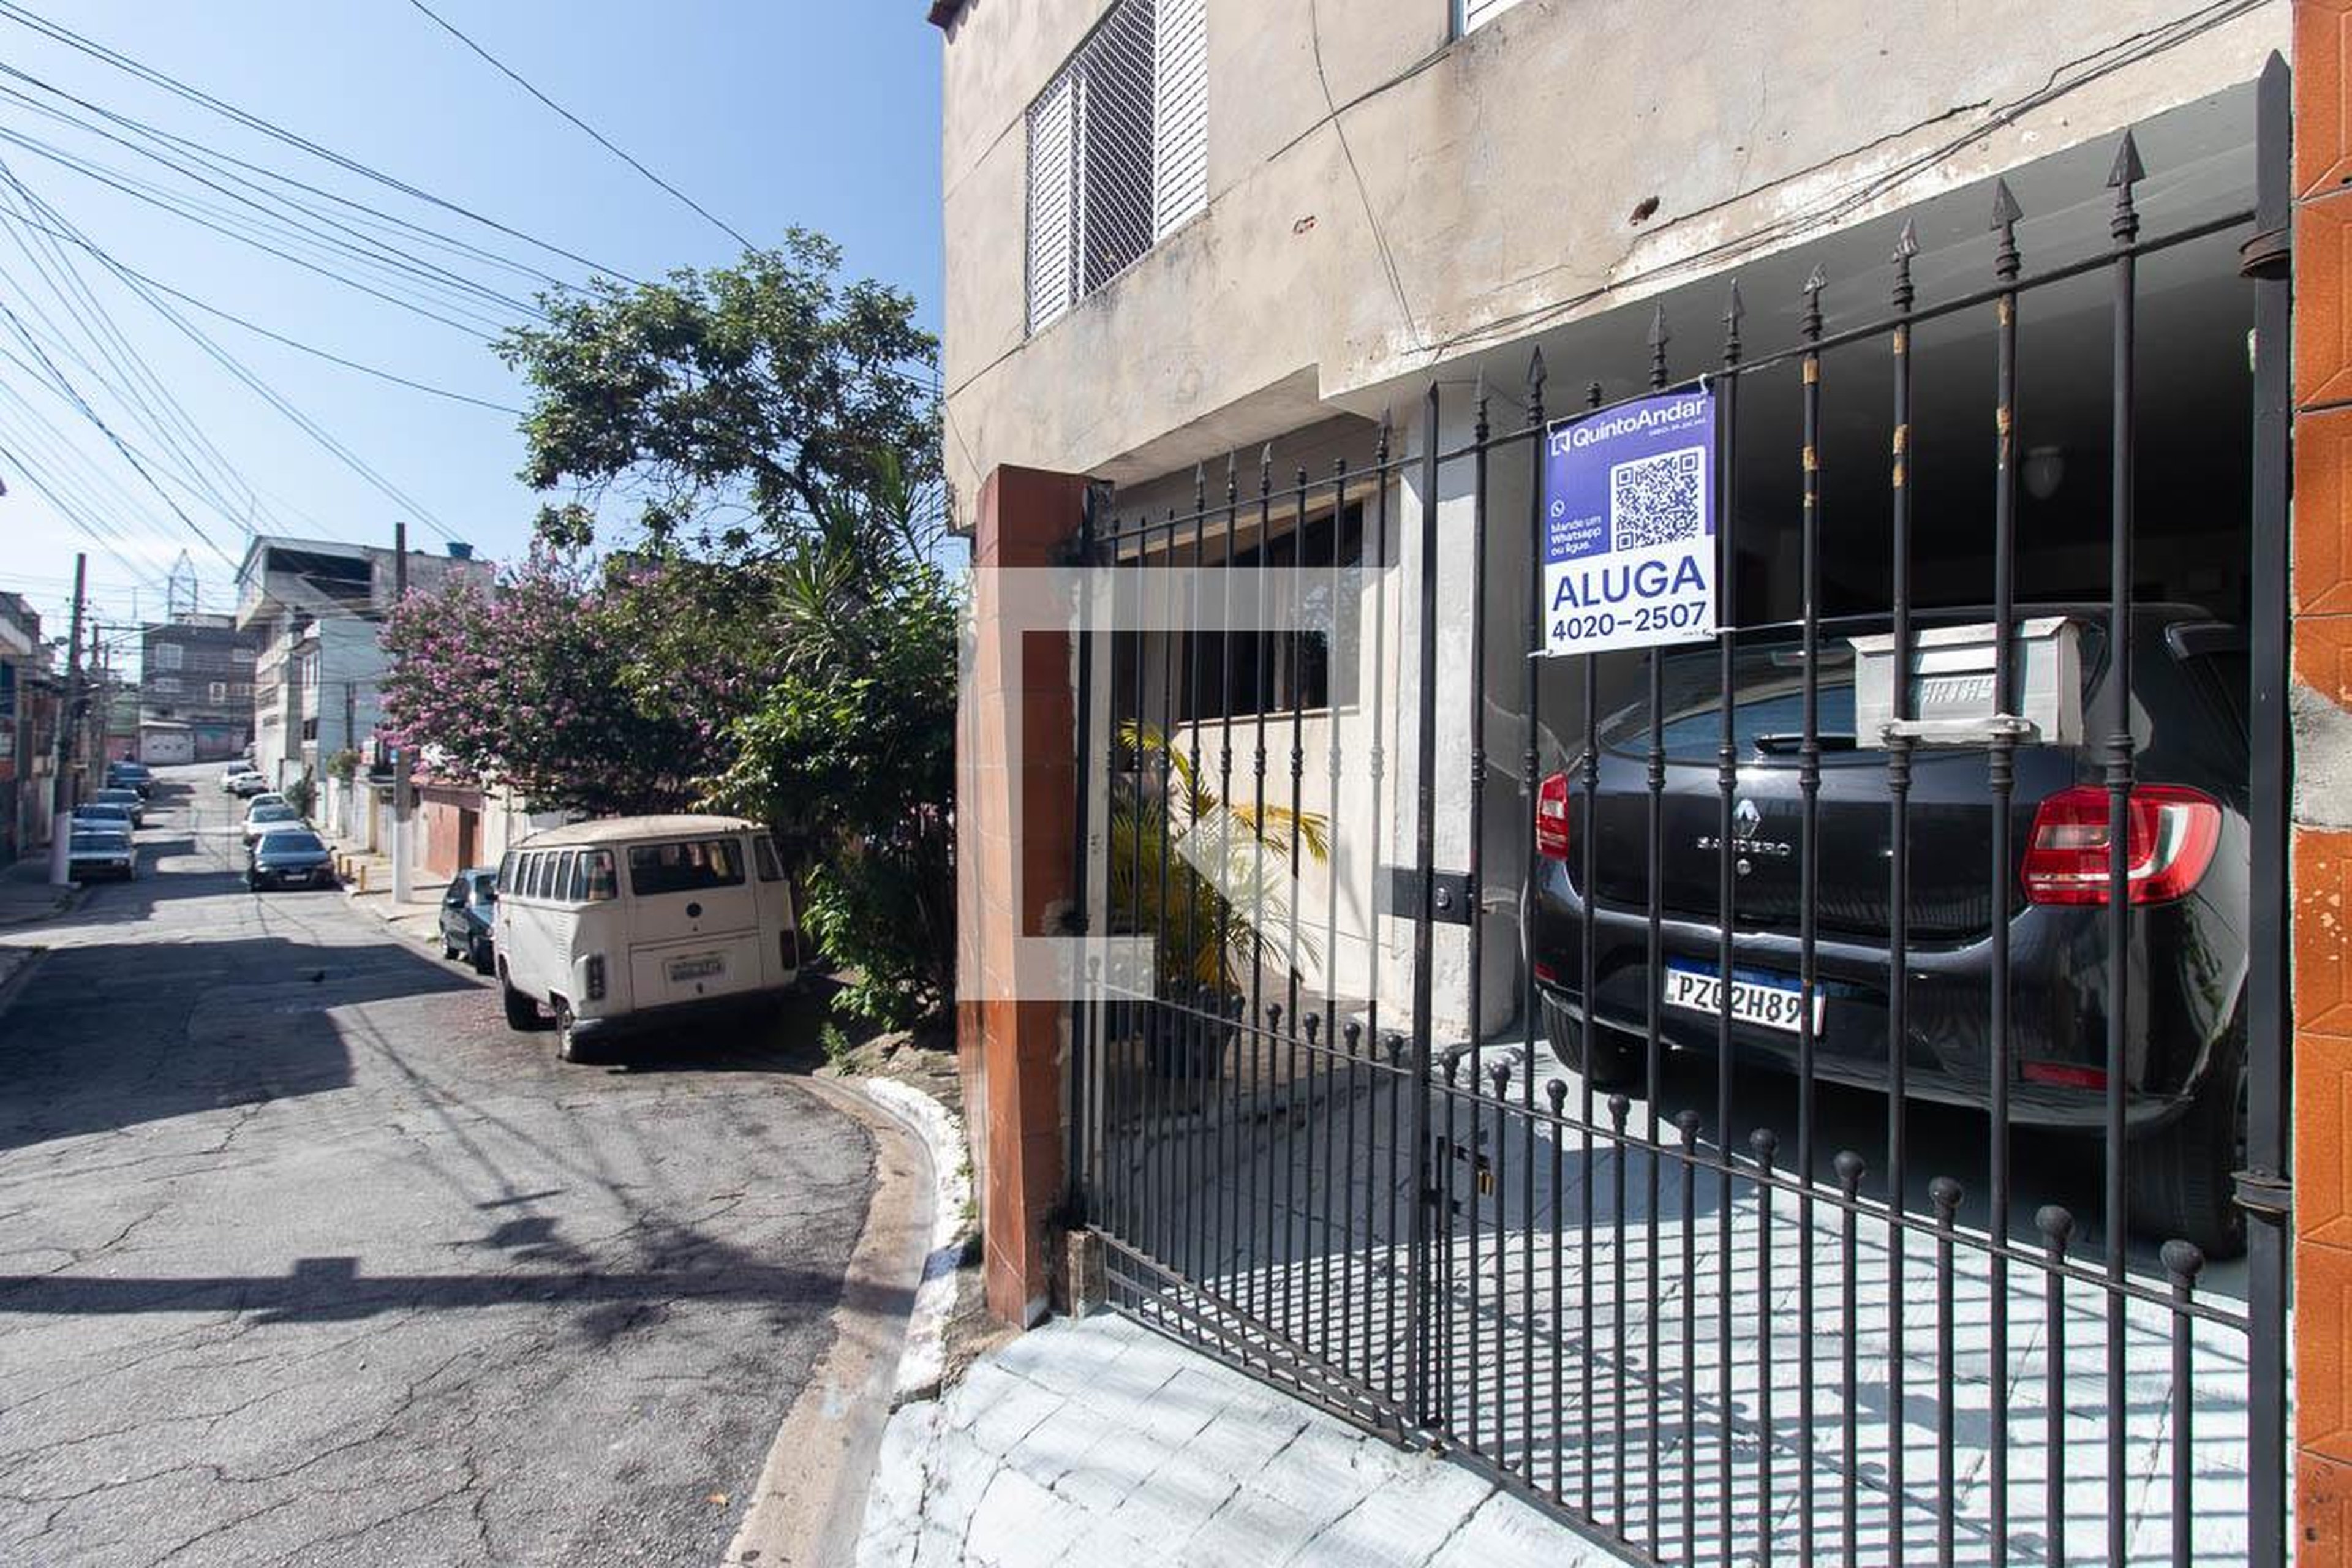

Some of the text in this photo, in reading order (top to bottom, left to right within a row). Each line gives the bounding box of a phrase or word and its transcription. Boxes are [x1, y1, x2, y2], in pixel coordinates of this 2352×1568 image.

[1572, 399, 1706, 447] QuintoAndar
[1552, 555, 1706, 611] ALUGA
[1552, 601, 1706, 641] 4020-2507
